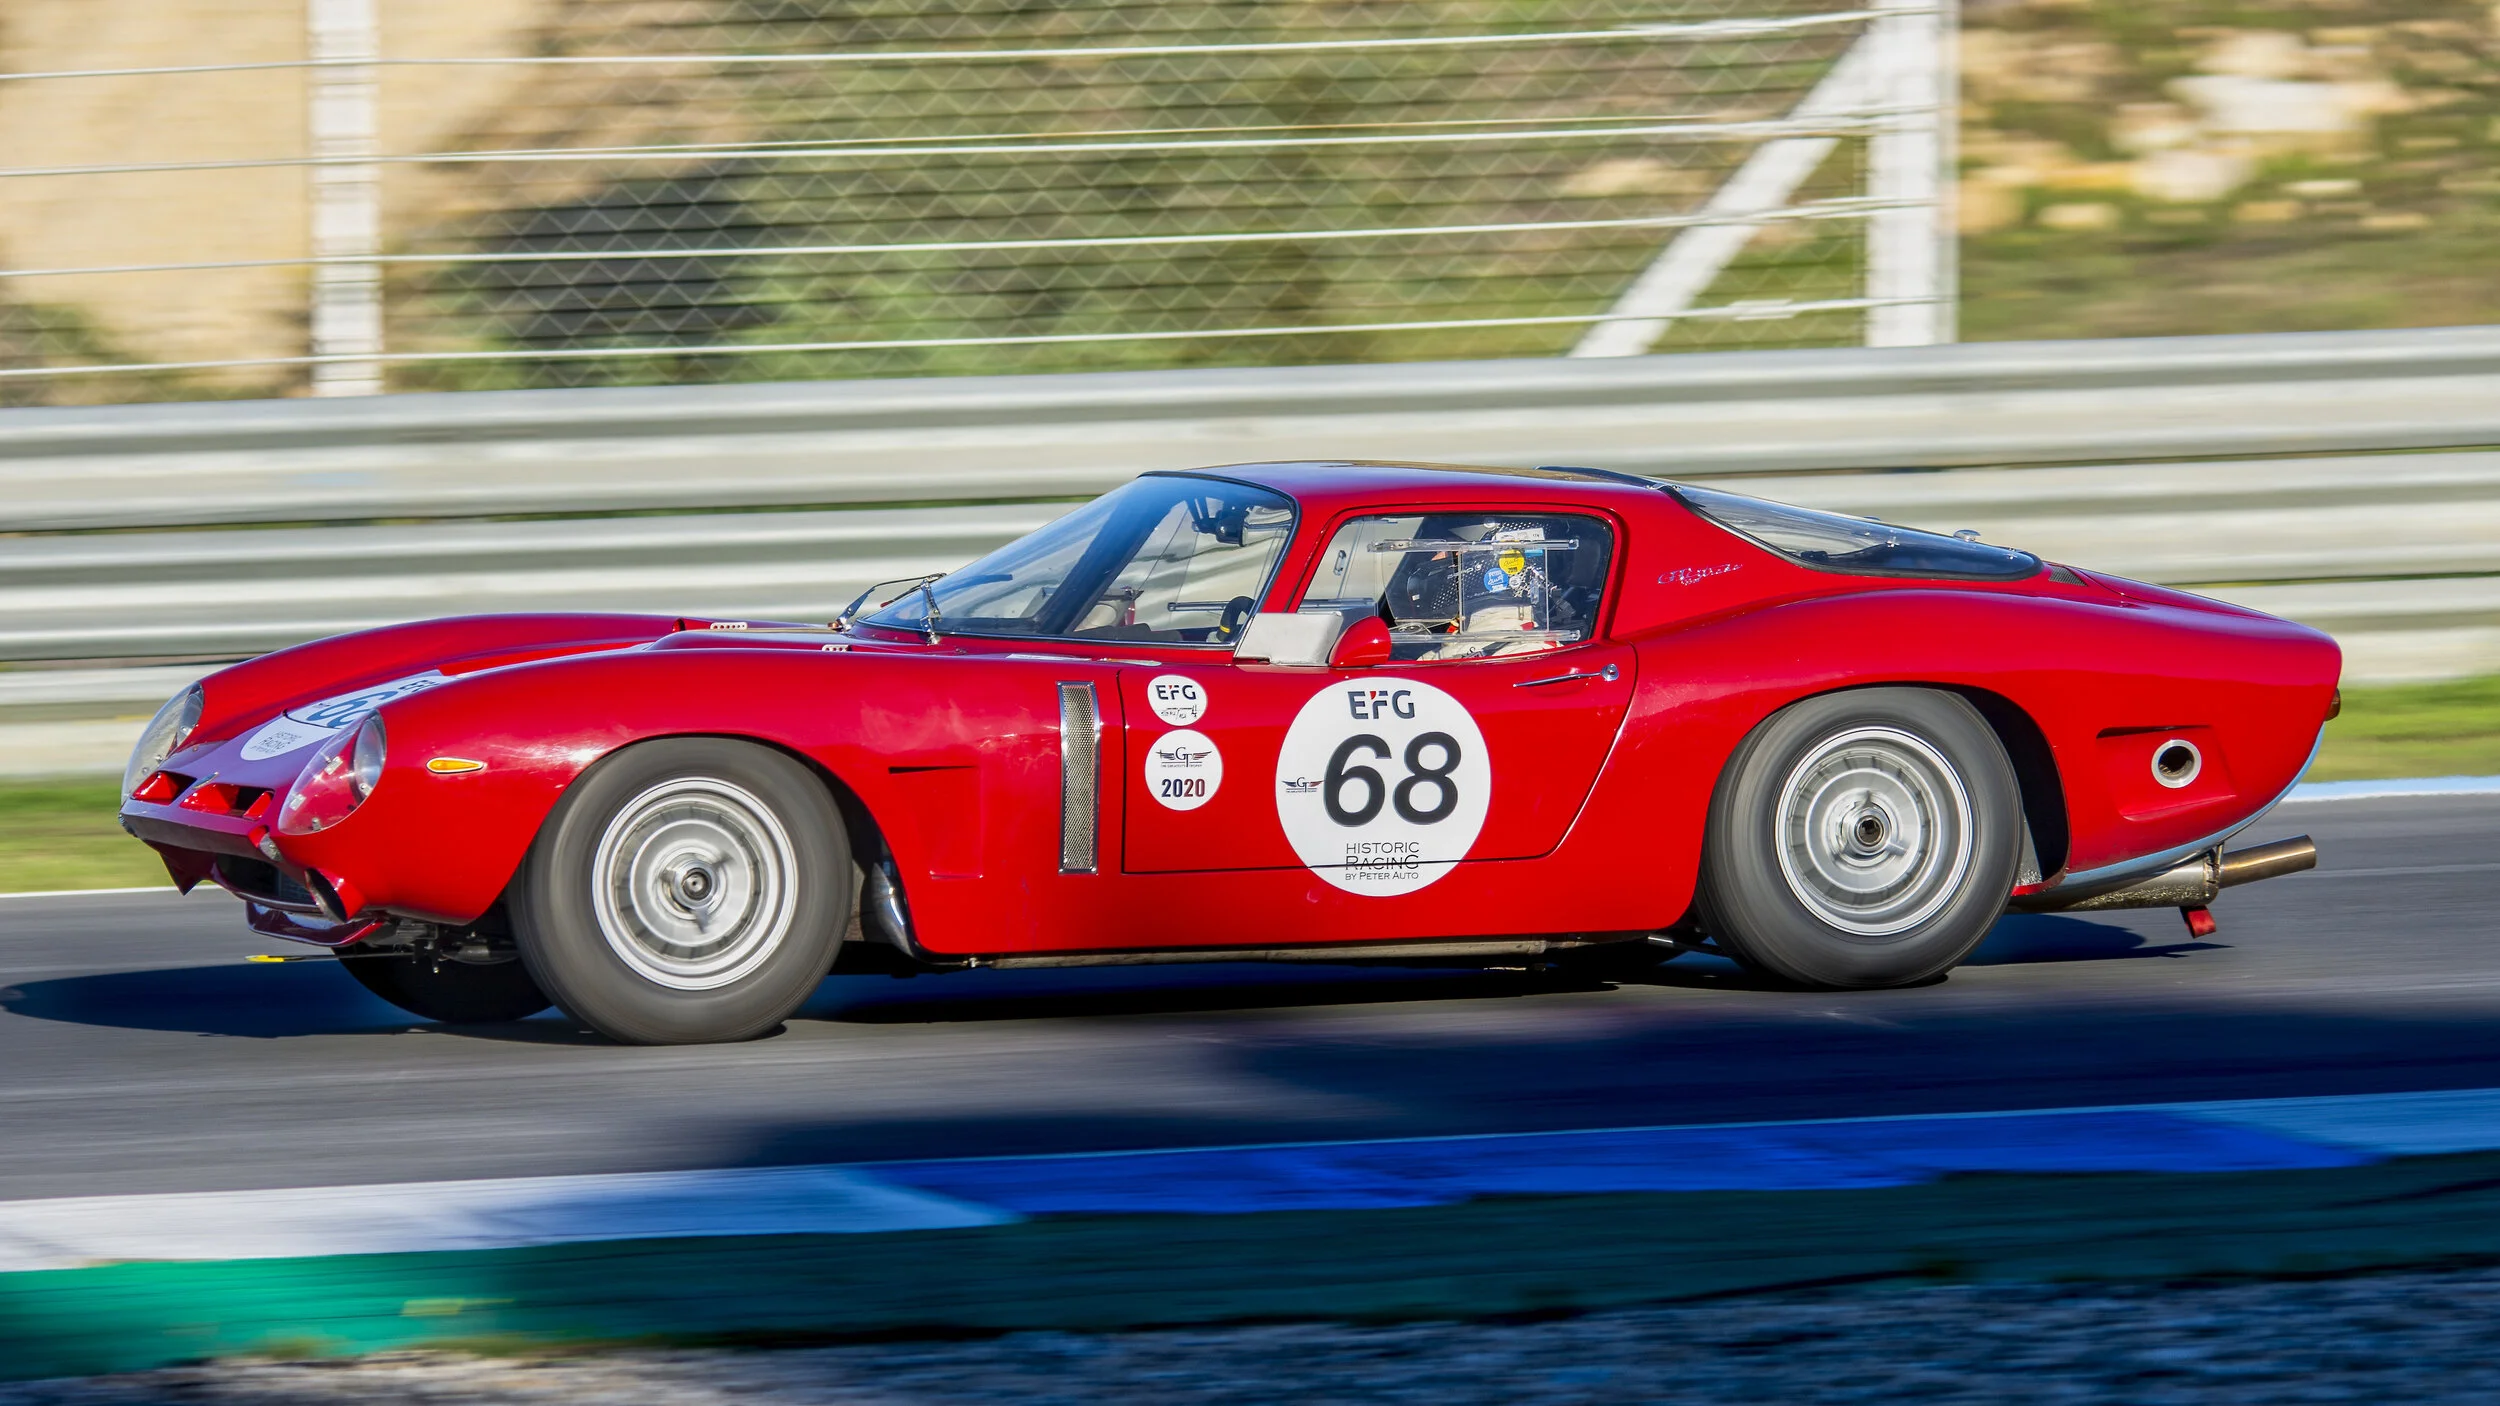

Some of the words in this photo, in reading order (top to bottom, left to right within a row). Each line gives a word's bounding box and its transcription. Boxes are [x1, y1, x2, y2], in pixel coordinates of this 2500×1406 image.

[1155, 684, 1197, 700] EFG
[1348, 690, 1416, 720] EFG
[1161, 778, 1206, 798] 2020
[1324, 731, 1462, 828] 68
[1345, 841, 1420, 854] HISTORIC
[1345, 854, 1420, 871] RACING
[1359, 872, 1390, 880] PETER
[1391, 871, 1419, 880] AUTO
